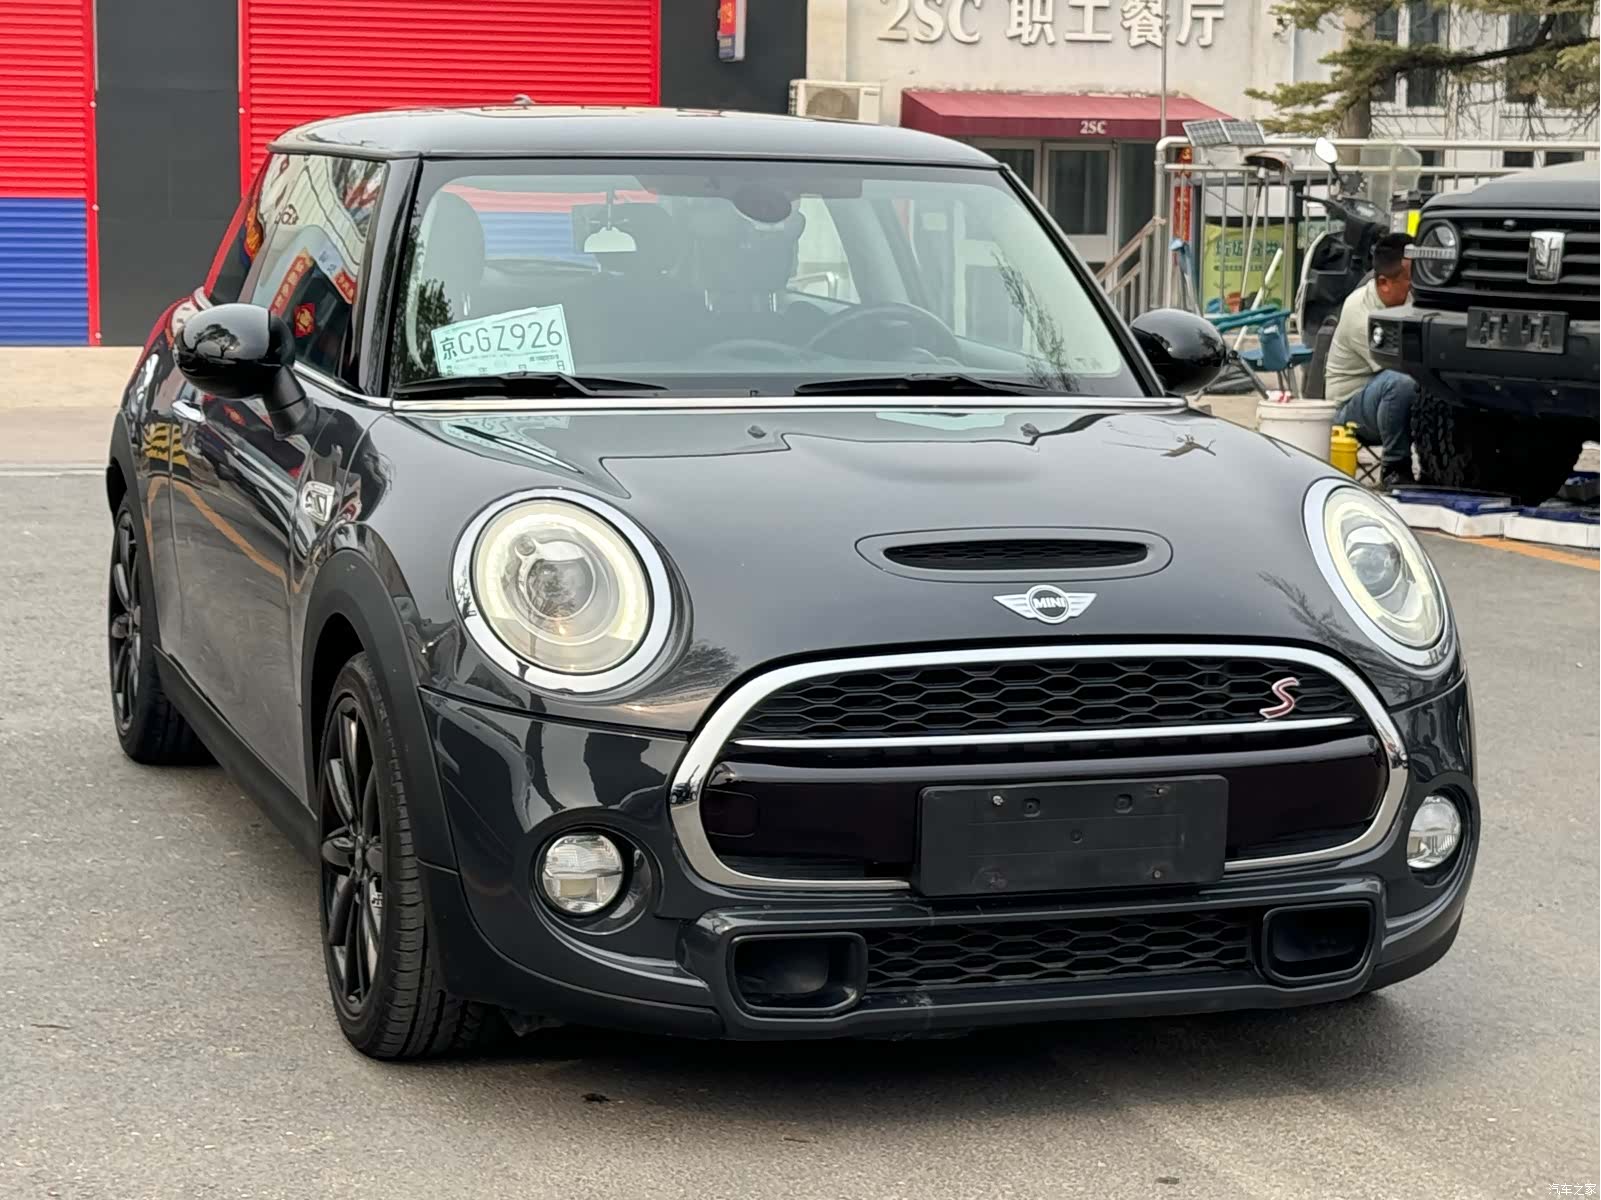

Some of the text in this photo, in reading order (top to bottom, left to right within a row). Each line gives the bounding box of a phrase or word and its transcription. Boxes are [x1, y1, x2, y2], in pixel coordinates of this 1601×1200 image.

[877, 0, 1225, 48] 2SC 职工餐厅
[1080, 119, 1107, 135] 2SC
[440, 319, 563, 361] 京CGZ926
[1032, 596, 1067, 609] MINI
[1259, 676, 1300, 719] S
